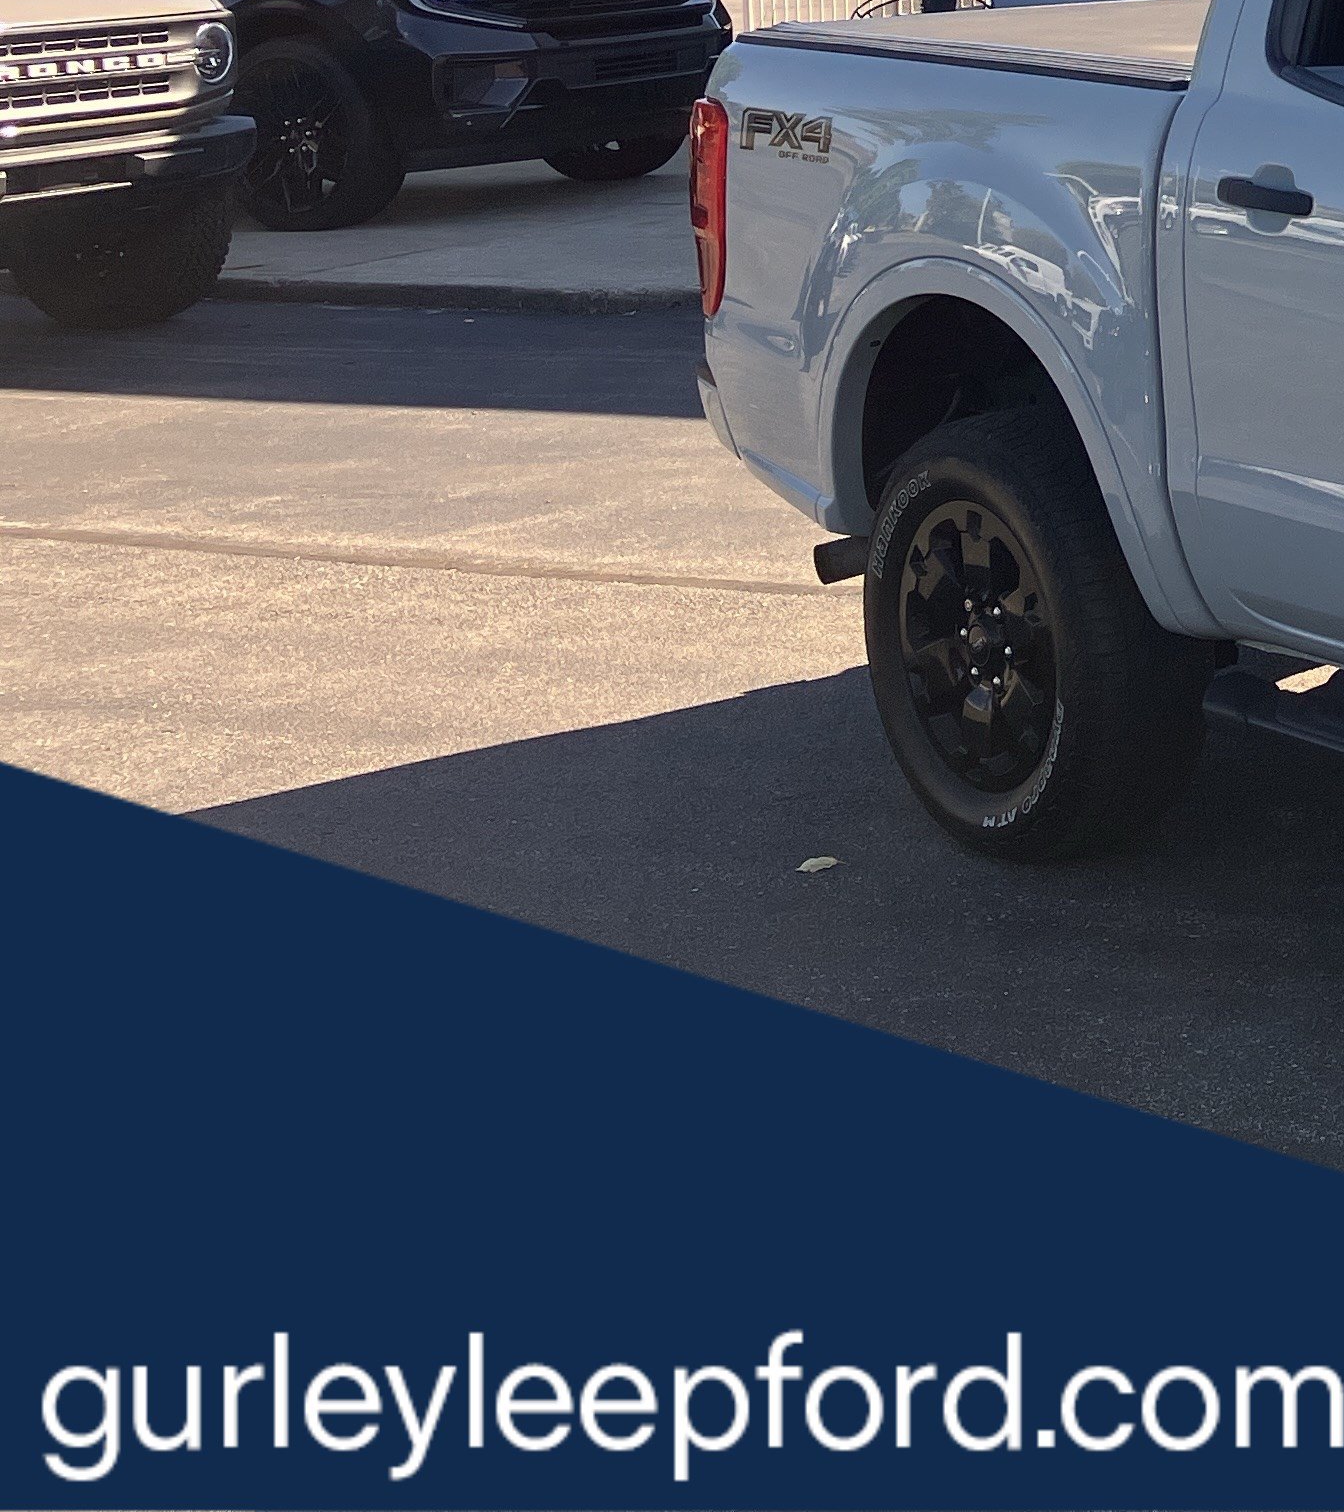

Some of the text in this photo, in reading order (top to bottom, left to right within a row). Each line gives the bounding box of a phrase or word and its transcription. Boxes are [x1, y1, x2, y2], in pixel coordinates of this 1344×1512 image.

[740, 107, 833, 153] FX4
[778, 150, 829, 165] OFF ROAD
